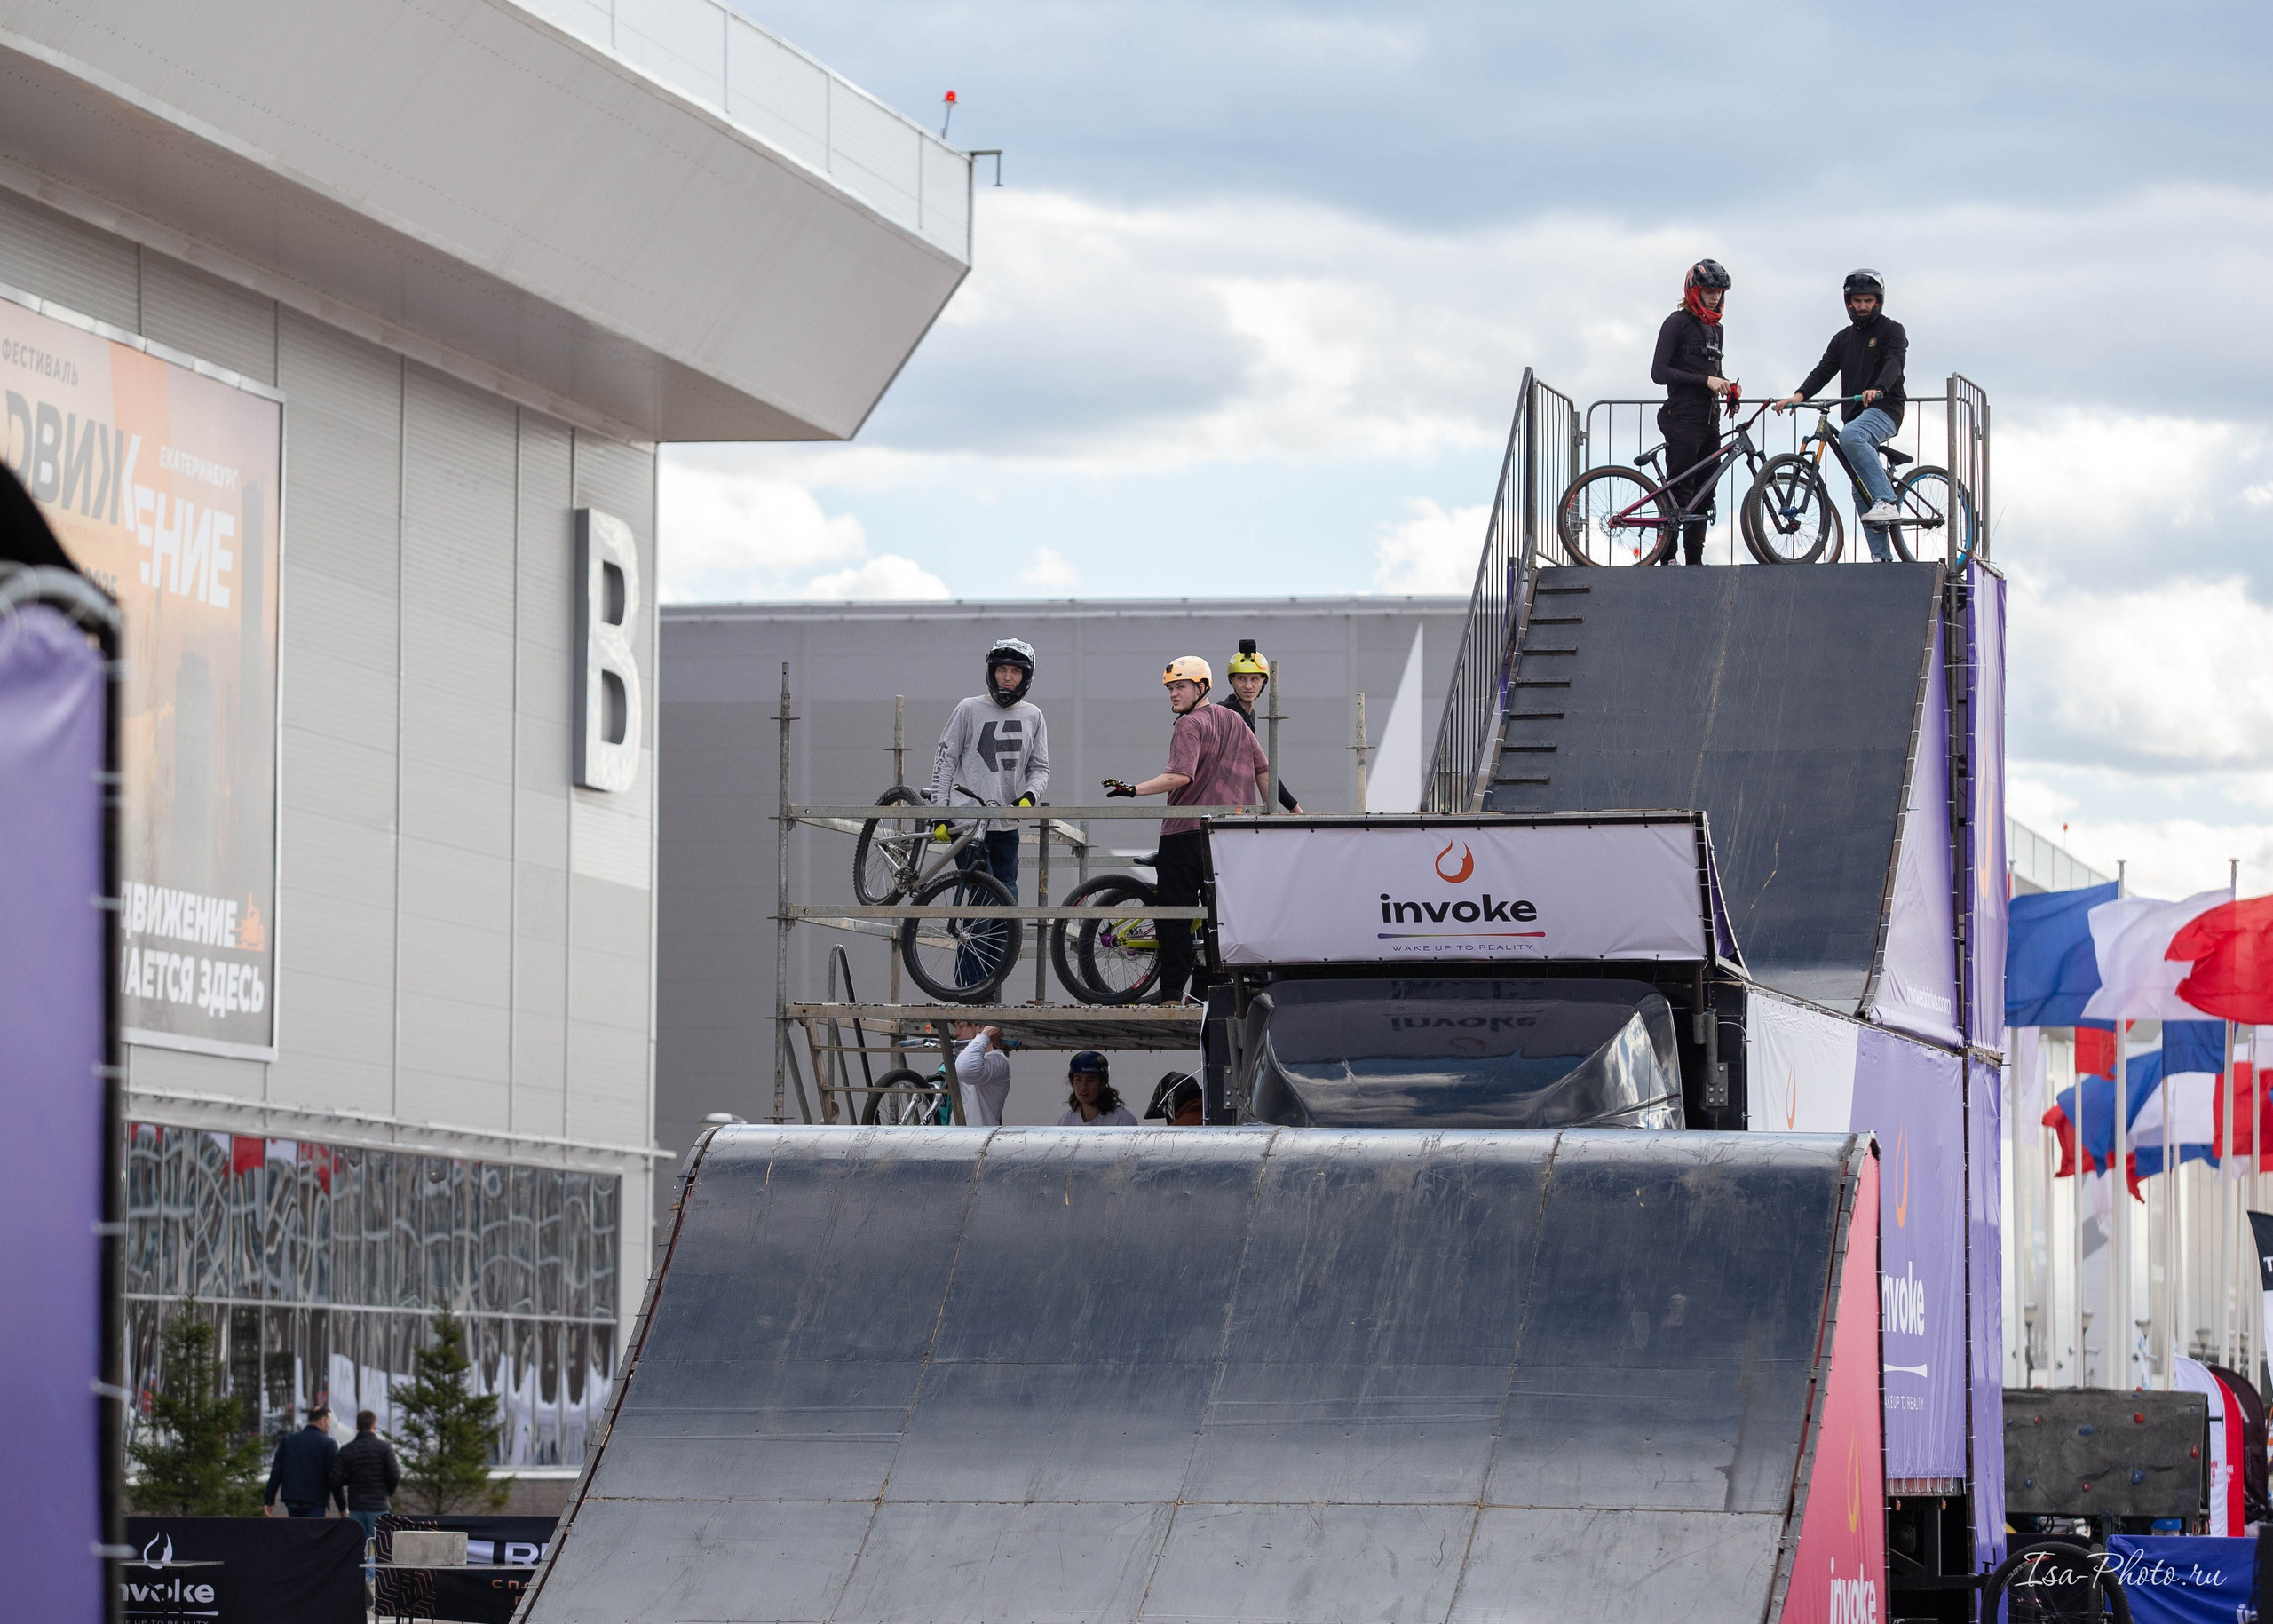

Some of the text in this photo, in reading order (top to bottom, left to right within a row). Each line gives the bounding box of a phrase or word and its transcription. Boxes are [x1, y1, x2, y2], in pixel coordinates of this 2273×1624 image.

[2, 337, 79, 386] ФЕСТИВАЛЬ
[159, 445, 239, 490] ЕКАТЕРИНБУРГ
[1380, 893, 1537, 923] invoke
[198, 959, 264, 1018] ЗДЕСЬ
[1881, 1260, 1925, 1336] nvoke
[118, 1578, 215, 1604] nvoke
[1830, 1556, 1877, 1624] invoke
